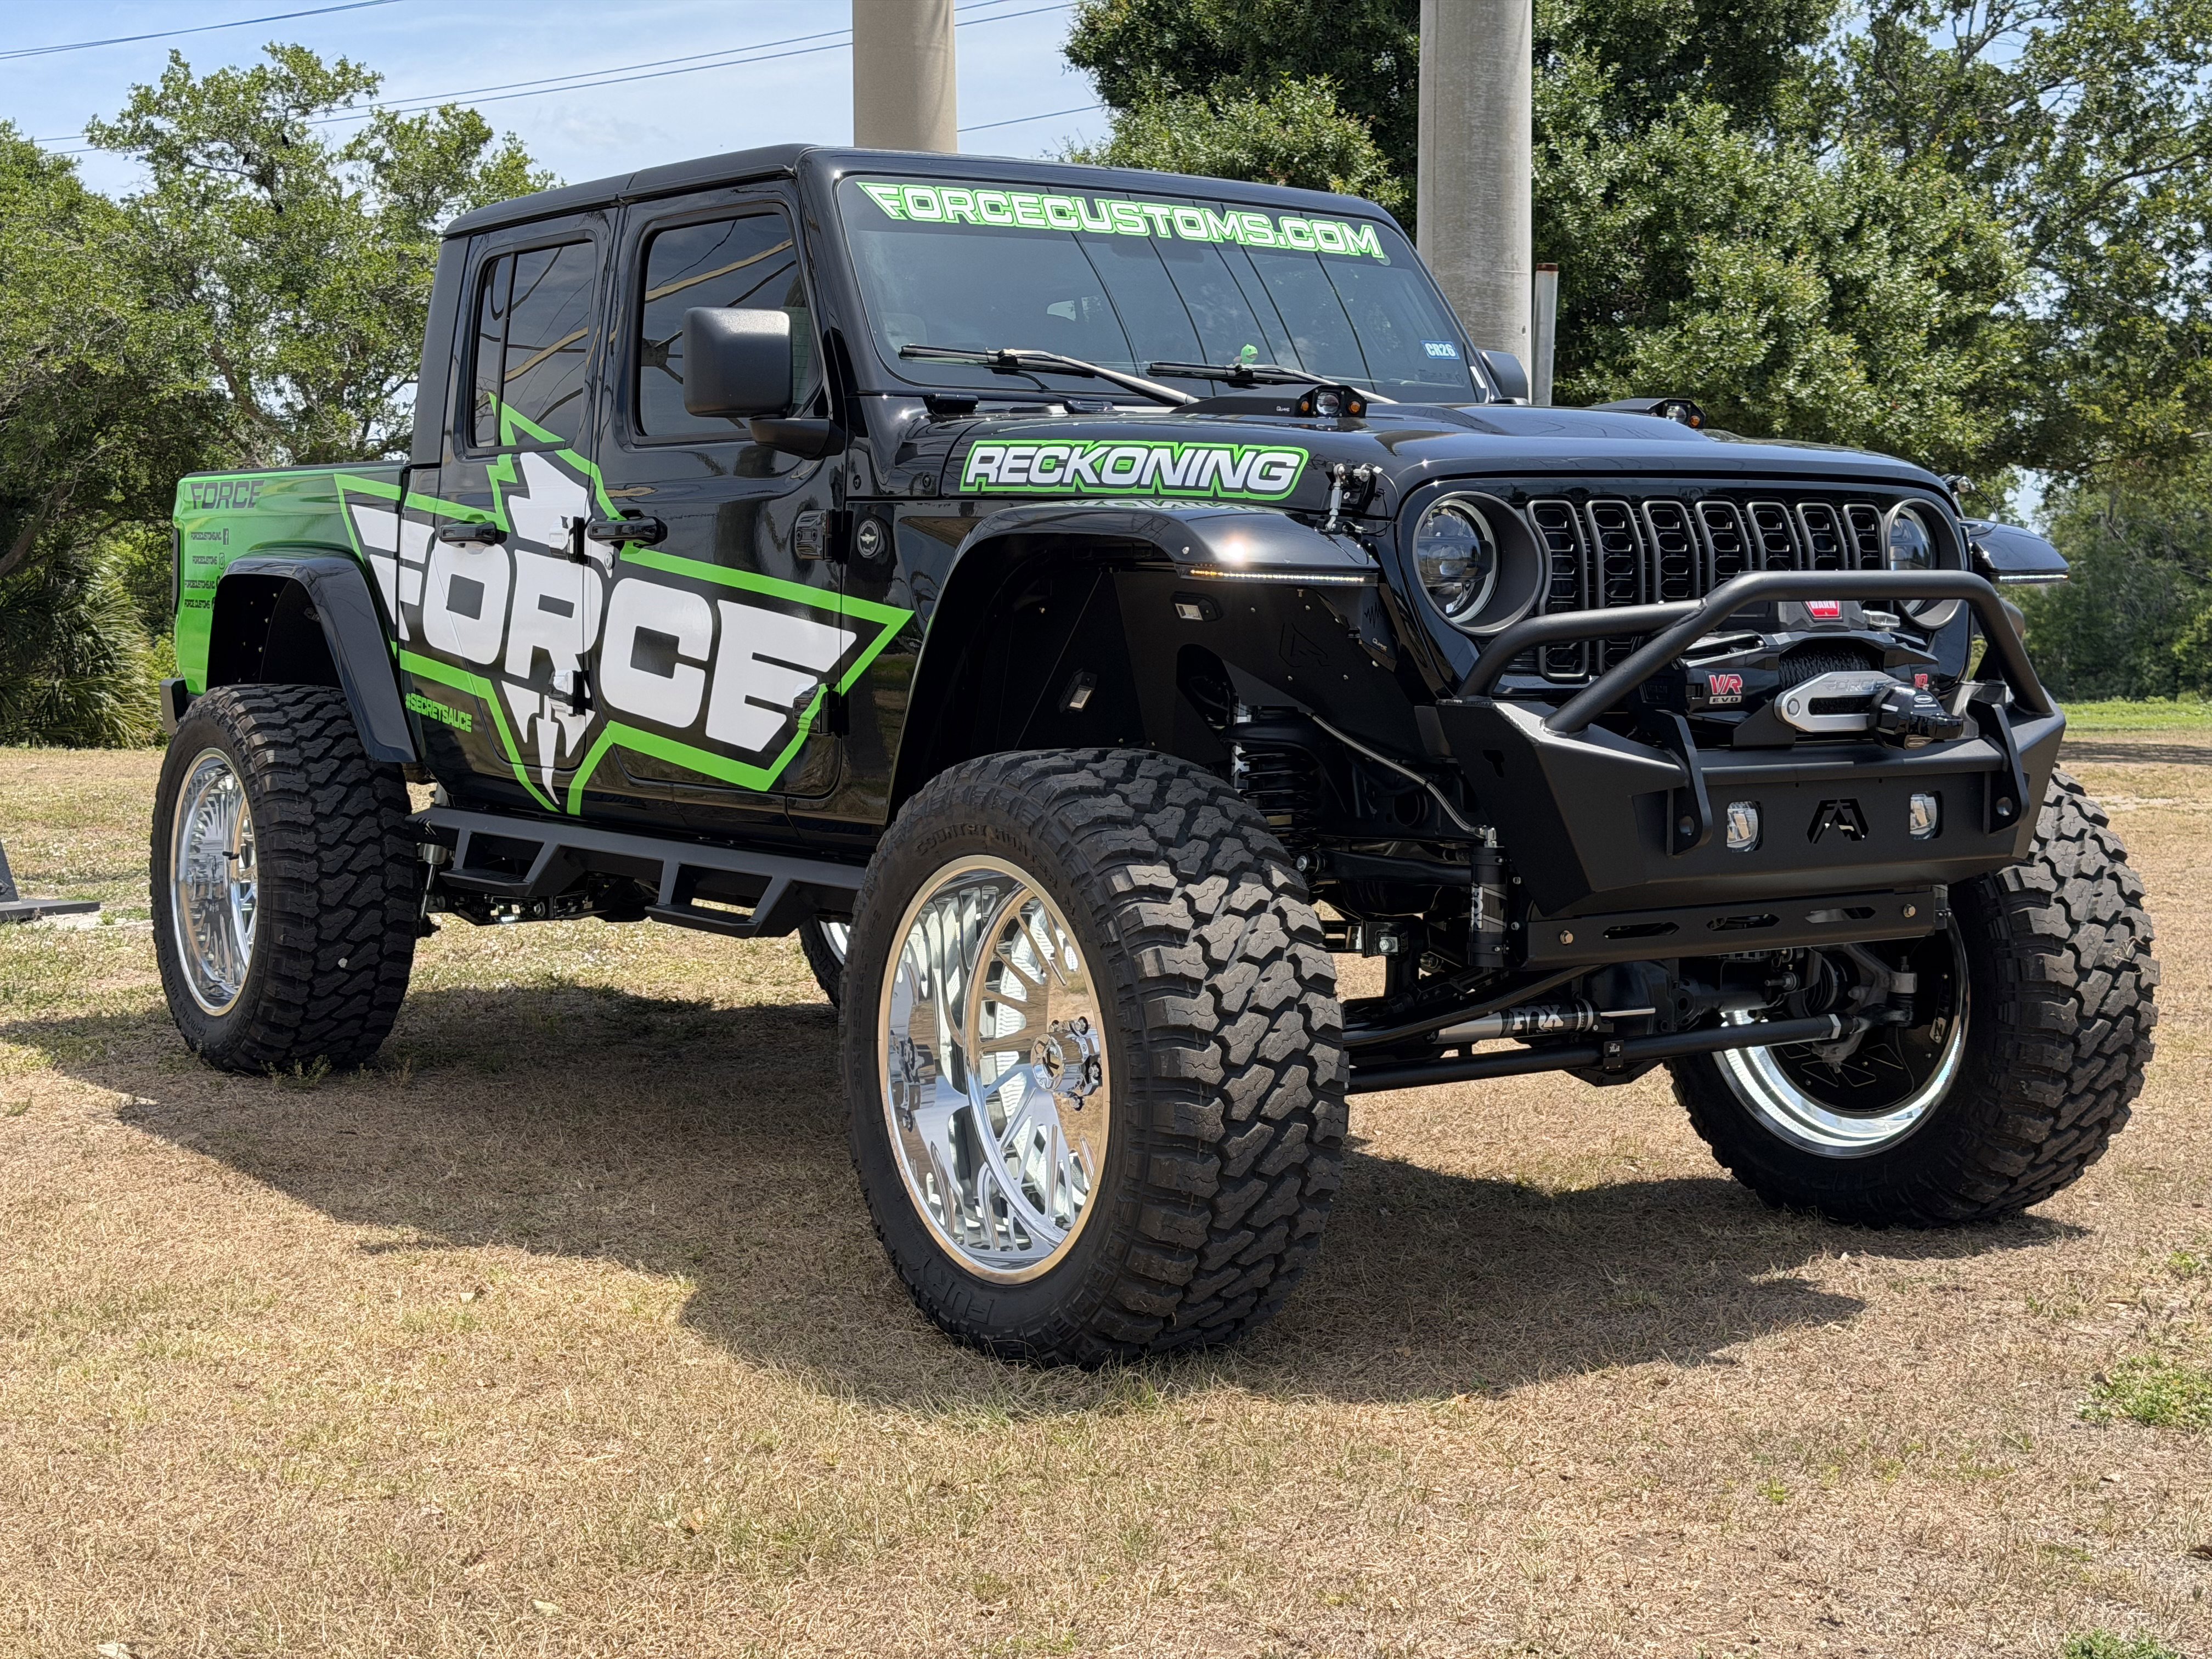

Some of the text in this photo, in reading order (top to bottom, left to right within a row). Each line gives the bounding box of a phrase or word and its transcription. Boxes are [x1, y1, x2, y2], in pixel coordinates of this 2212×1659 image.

[857, 182, 1384, 258] FORCECUSTOMS.COM
[1425, 343, 1456, 357] CR26
[963, 443, 1304, 495] RECKONING
[190, 480, 265, 509] FORCE
[350, 504, 856, 752] FORCE
[1709, 674, 1742, 695] VR
[405, 692, 472, 733] #SECRETSAUCE
[1509, 1005, 1564, 1035] FOX
